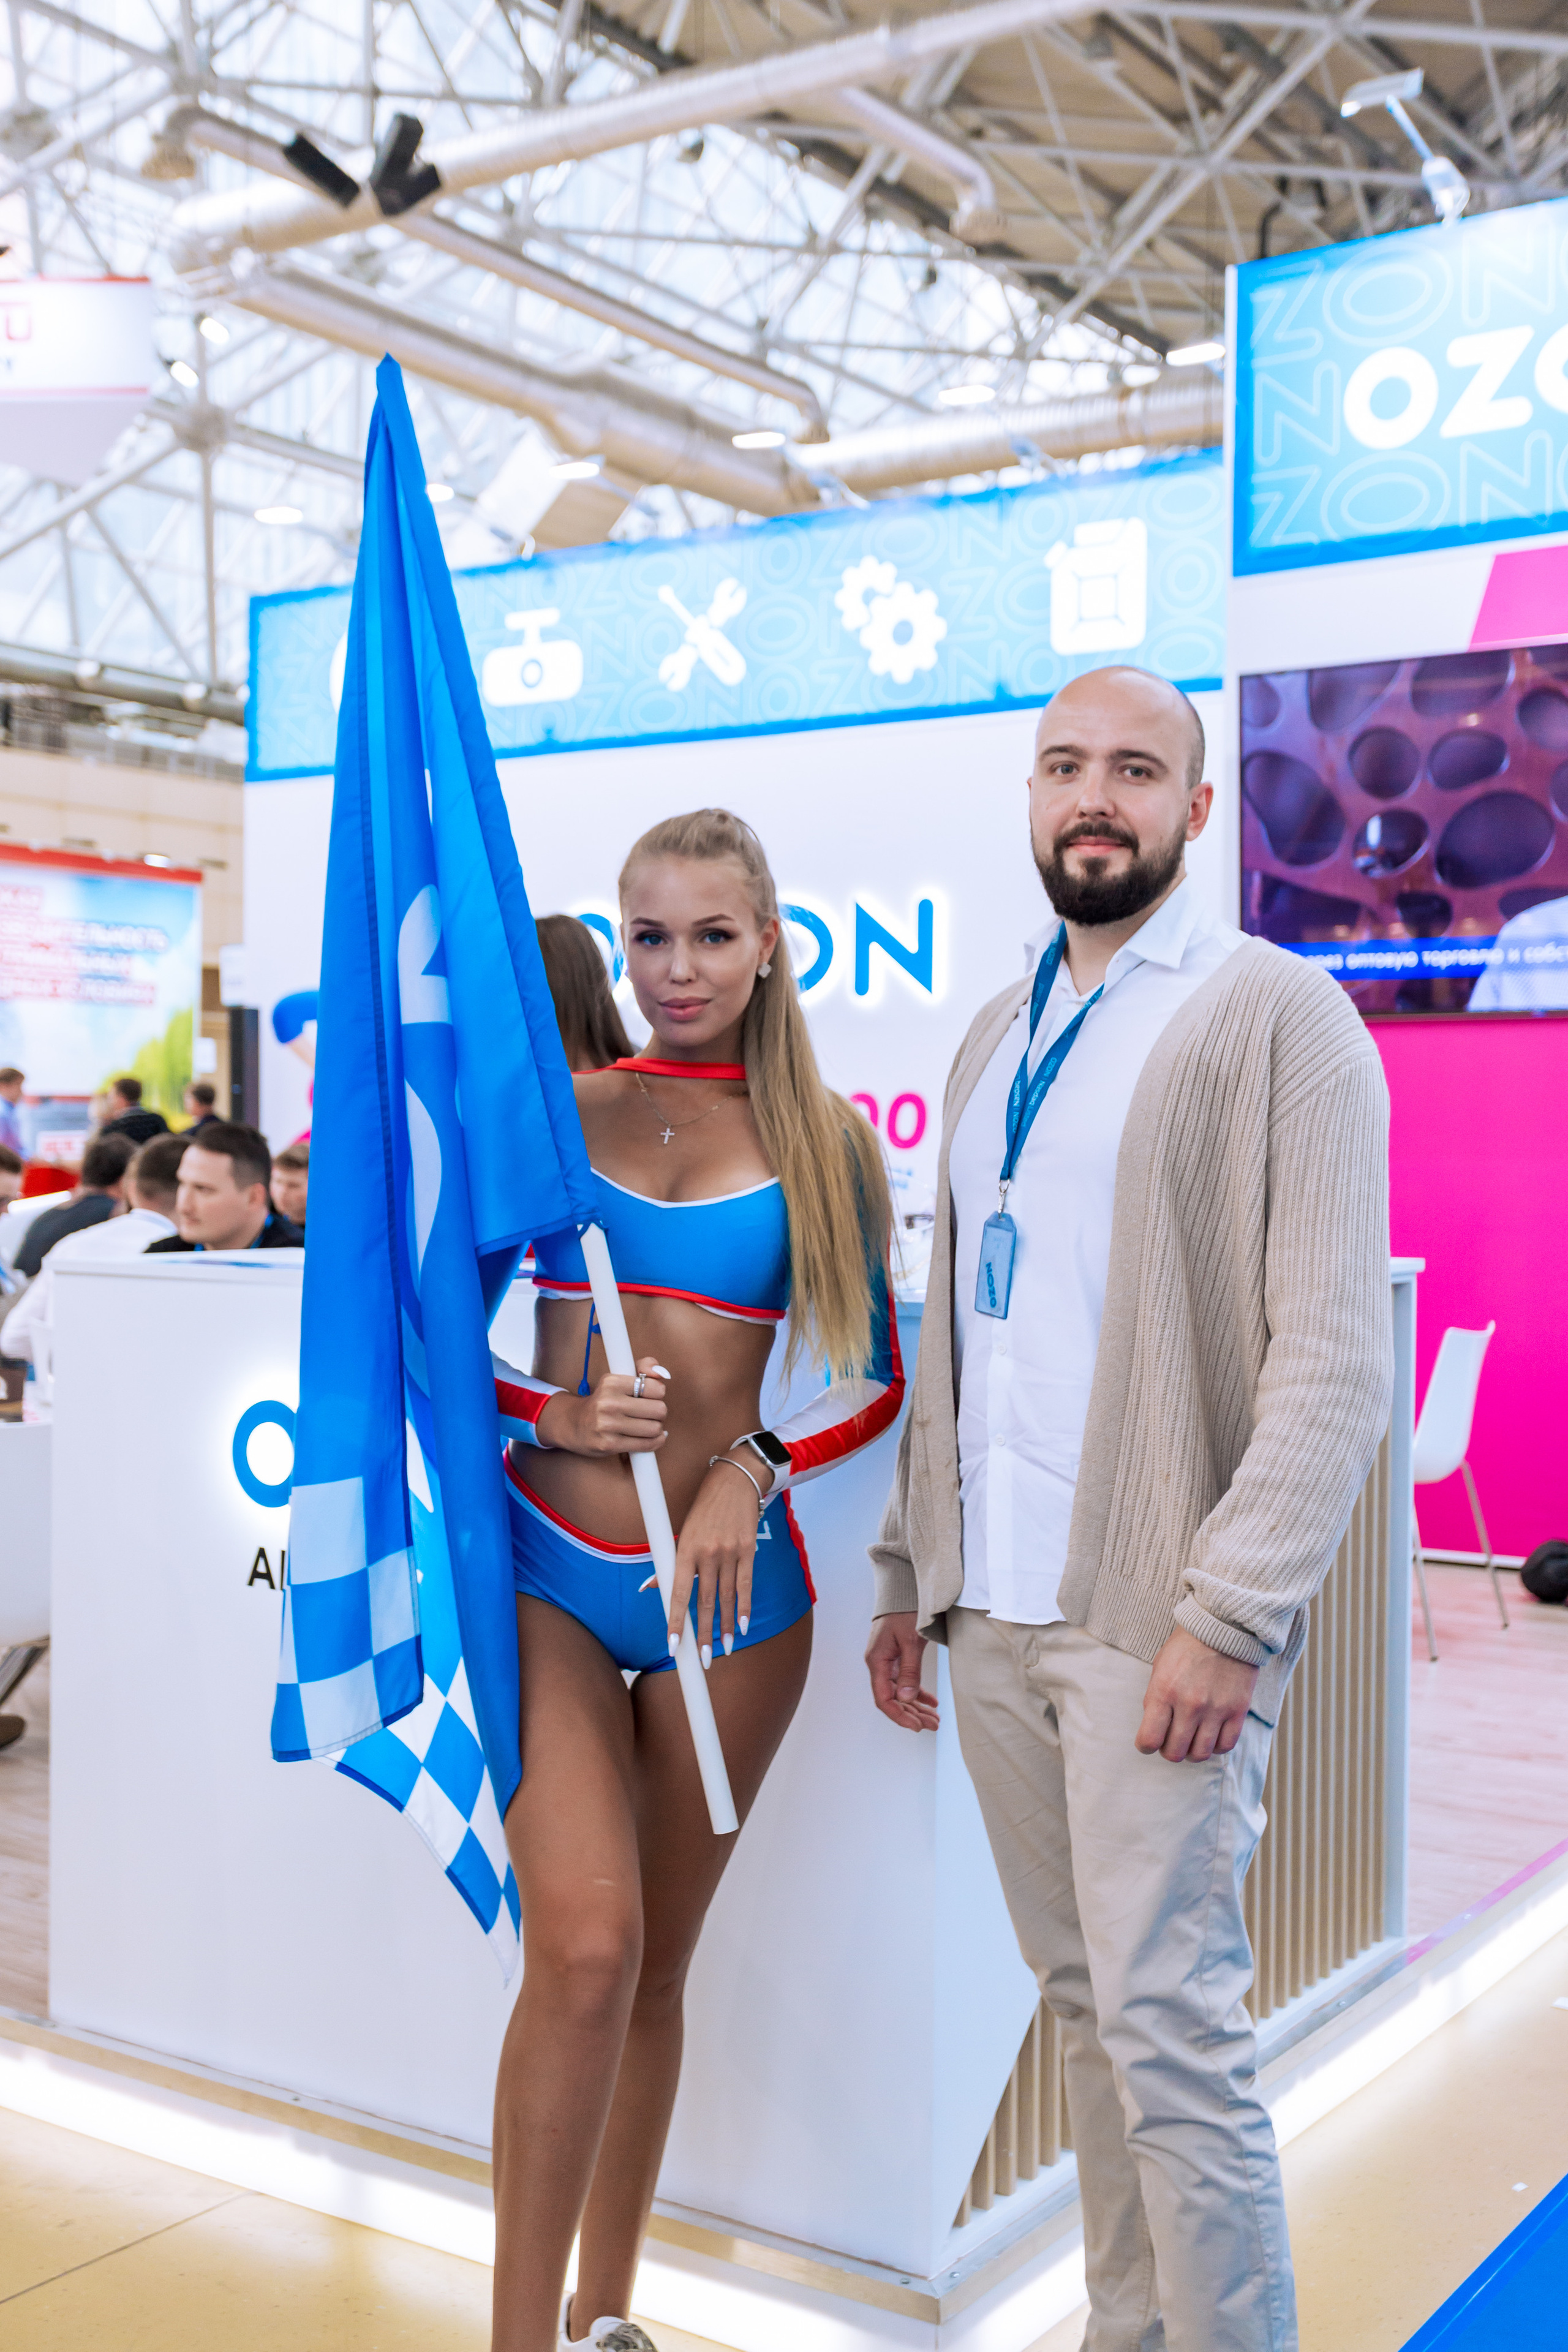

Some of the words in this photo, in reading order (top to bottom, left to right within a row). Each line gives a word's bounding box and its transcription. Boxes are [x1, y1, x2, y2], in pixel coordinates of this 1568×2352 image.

[1345, 951, 1419, 971] оптовую
[1422, 948, 1505, 970] торговлю
[1507, 947, 1520, 964] и
[1044, 1057, 1057, 1077] OZON
[1029, 1080, 1046, 1106] Nasdaq
[986, 1262, 997, 1308] OZON
